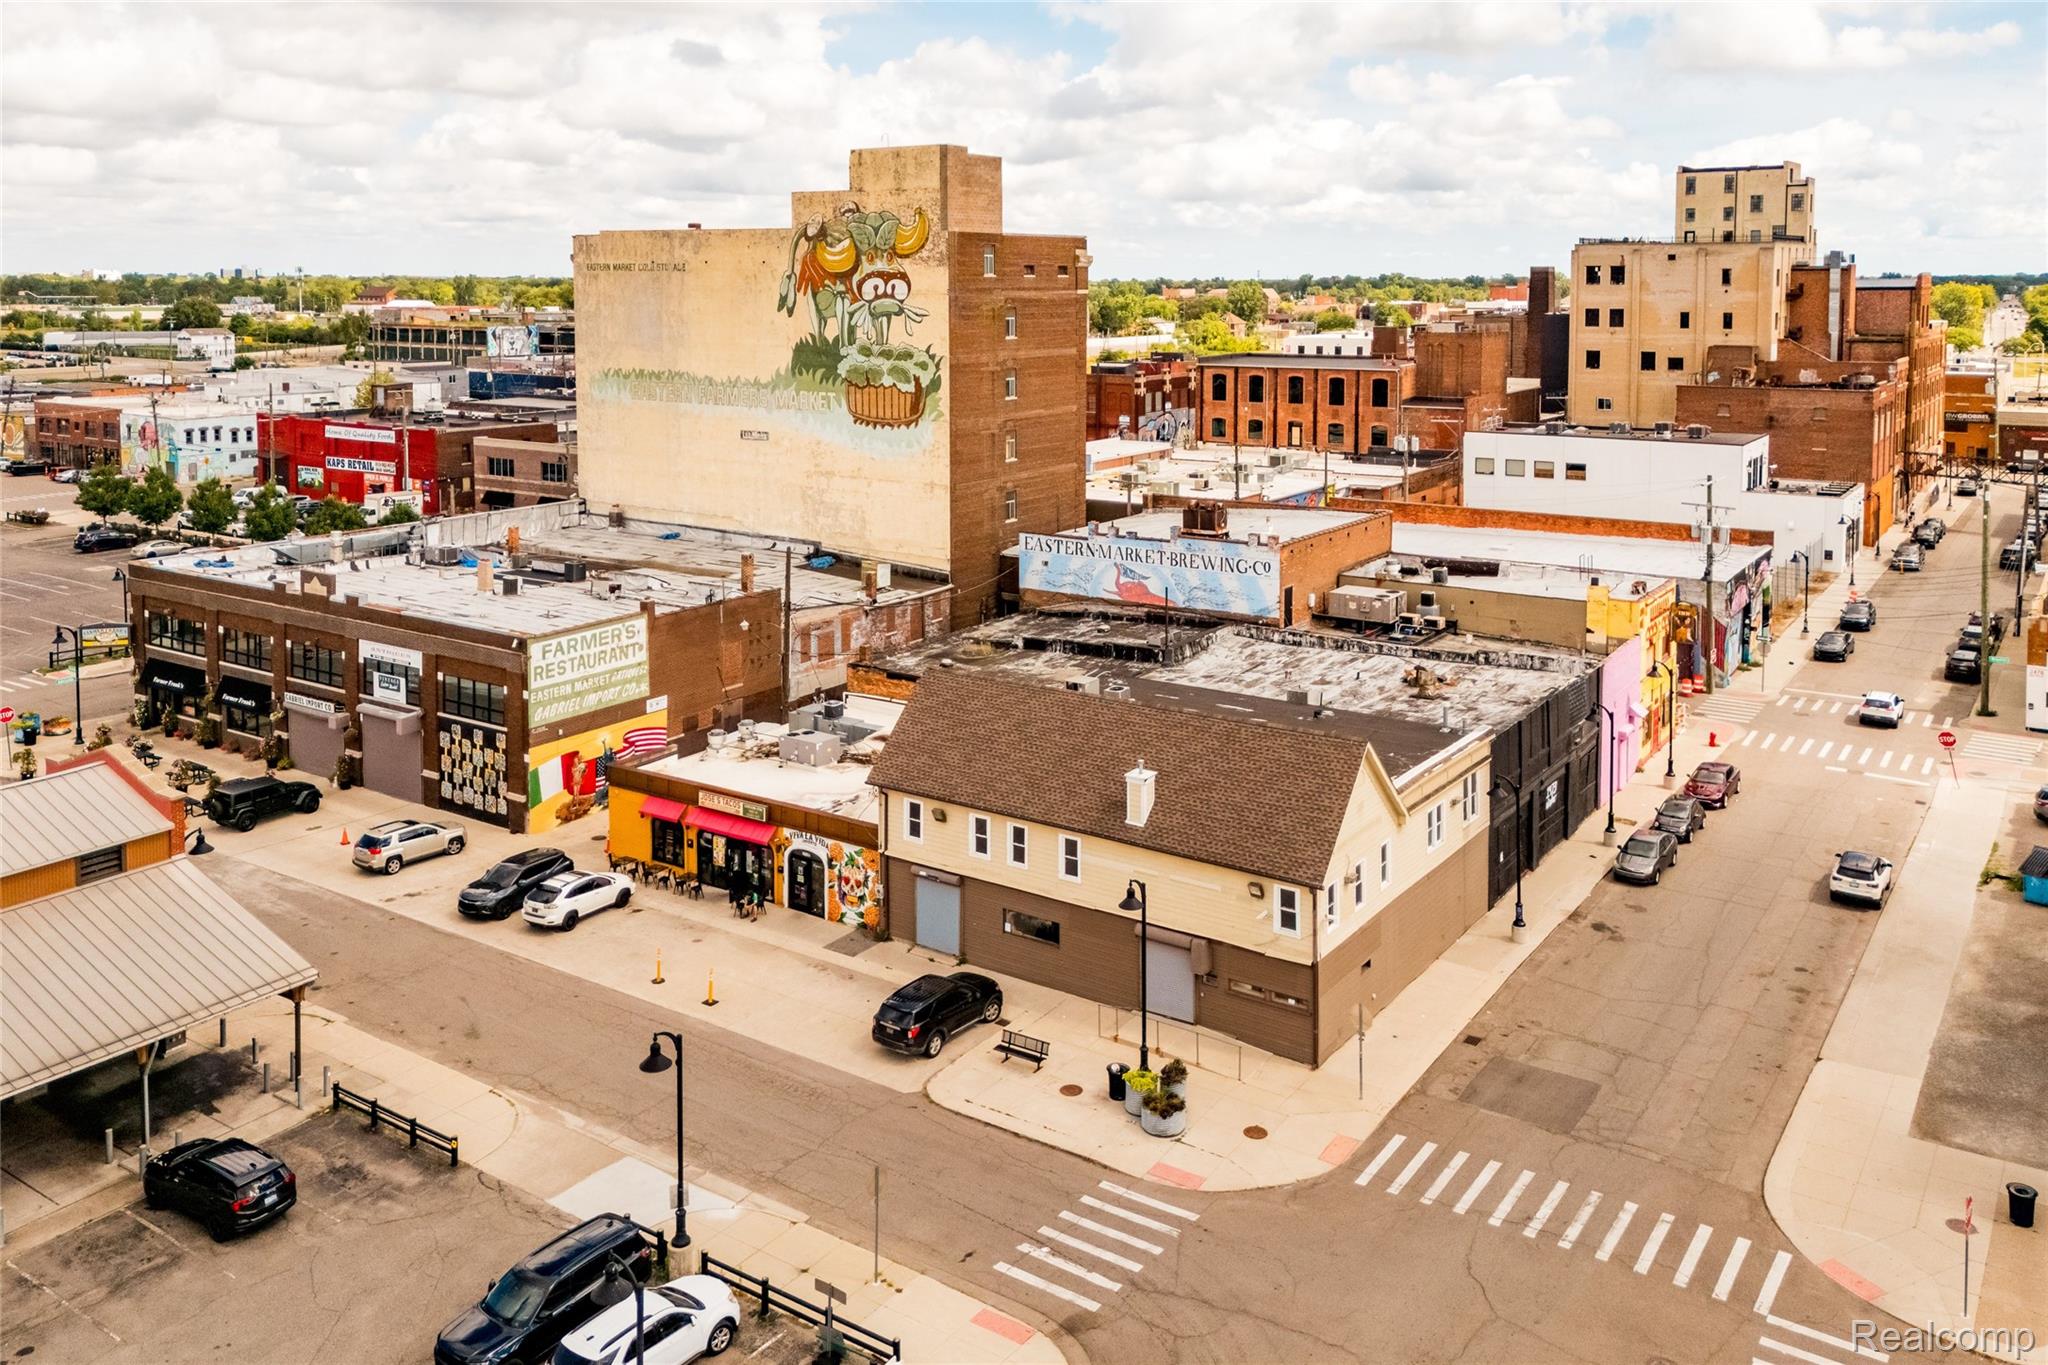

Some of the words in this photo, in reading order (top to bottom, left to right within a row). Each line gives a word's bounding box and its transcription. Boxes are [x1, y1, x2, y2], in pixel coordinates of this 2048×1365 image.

[586, 263, 611, 272] EASTERN
[612, 263, 636, 272] MARKET
[775, 390, 836, 411] MARKET
[352, 431, 376, 440] Quality
[327, 458, 345, 468] KAPS
[347, 460, 374, 471] RETAIL
[1024, 536, 1096, 557] EASTERN
[1099, 544, 1166, 565] MARKET
[1169, 551, 1248, 574] BREWING
[533, 642, 640, 682] RESTAURANT
[531, 684, 572, 704] EASTERN
[574, 674, 612, 692] MARKET
[534, 697, 581, 721] GABRIEL
[582, 686, 621, 709] IMPORT
[0, 710, 13, 719] STOP
[1938, 735, 1956, 743] STOP
[721, 798, 741, 811] TACOS
[789, 831, 804, 840] VIVA
[804, 832, 813, 841] LA
[814, 834, 829, 848] VIDA
